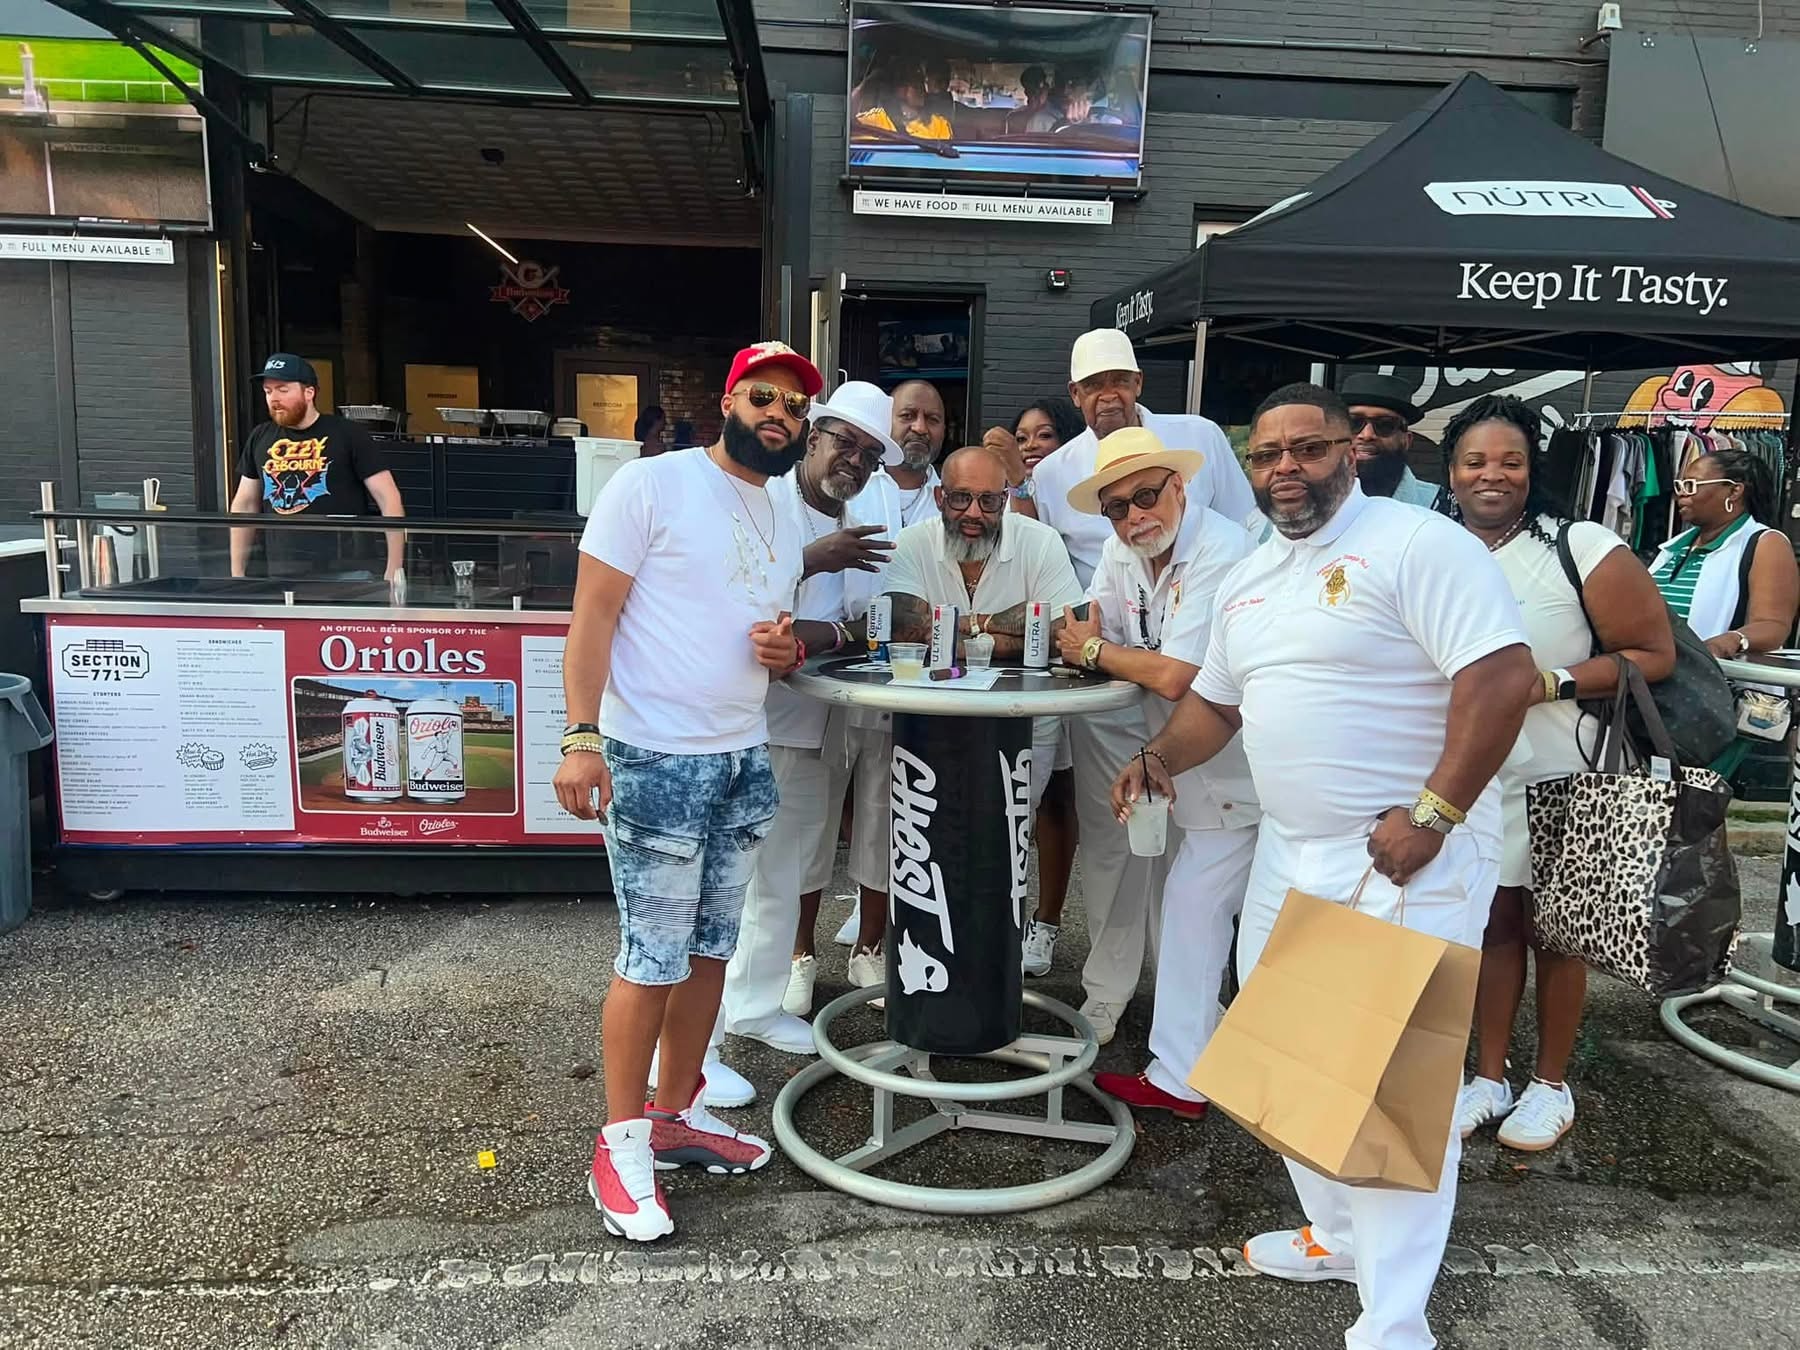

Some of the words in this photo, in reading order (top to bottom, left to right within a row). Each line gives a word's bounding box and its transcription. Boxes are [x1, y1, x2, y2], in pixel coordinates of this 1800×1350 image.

[874, 199, 890, 208] WE
[894, 201, 921, 210] HAVE
[926, 202, 958, 211] FOOD
[975, 203, 998, 213] FULL
[1002, 204, 1033, 214] MENU
[1037, 206, 1092, 217] AVAILABLE
[22, 242, 47, 252] FULL
[52, 243, 85, 253] MENU
[90, 245, 150, 256] AVAILABLE
[1457, 262, 1562, 310] Keep
[1568, 265, 1602, 302] It
[1611, 265, 1729, 316] Tasty.
[1115, 302, 1130, 330] Keep
[1135, 289, 1154, 324] Tasty.
[335, 625, 377, 633] OFFICIAL
[406, 627, 451, 635] SPONSOR
[932, 624, 941, 662] ULTRA
[1029, 620, 1041, 657] ULTRA
[71, 654, 141, 668] SECTION
[320, 635, 487, 674] Orioles
[91, 669, 122, 682] 771
[373, 721, 386, 782] Budweiser
[409, 780, 464, 792] Budweiser
[360, 827, 408, 836] Budweiser
[419, 818, 456, 835] Orioles
[890, 744, 954, 955] GHOST
